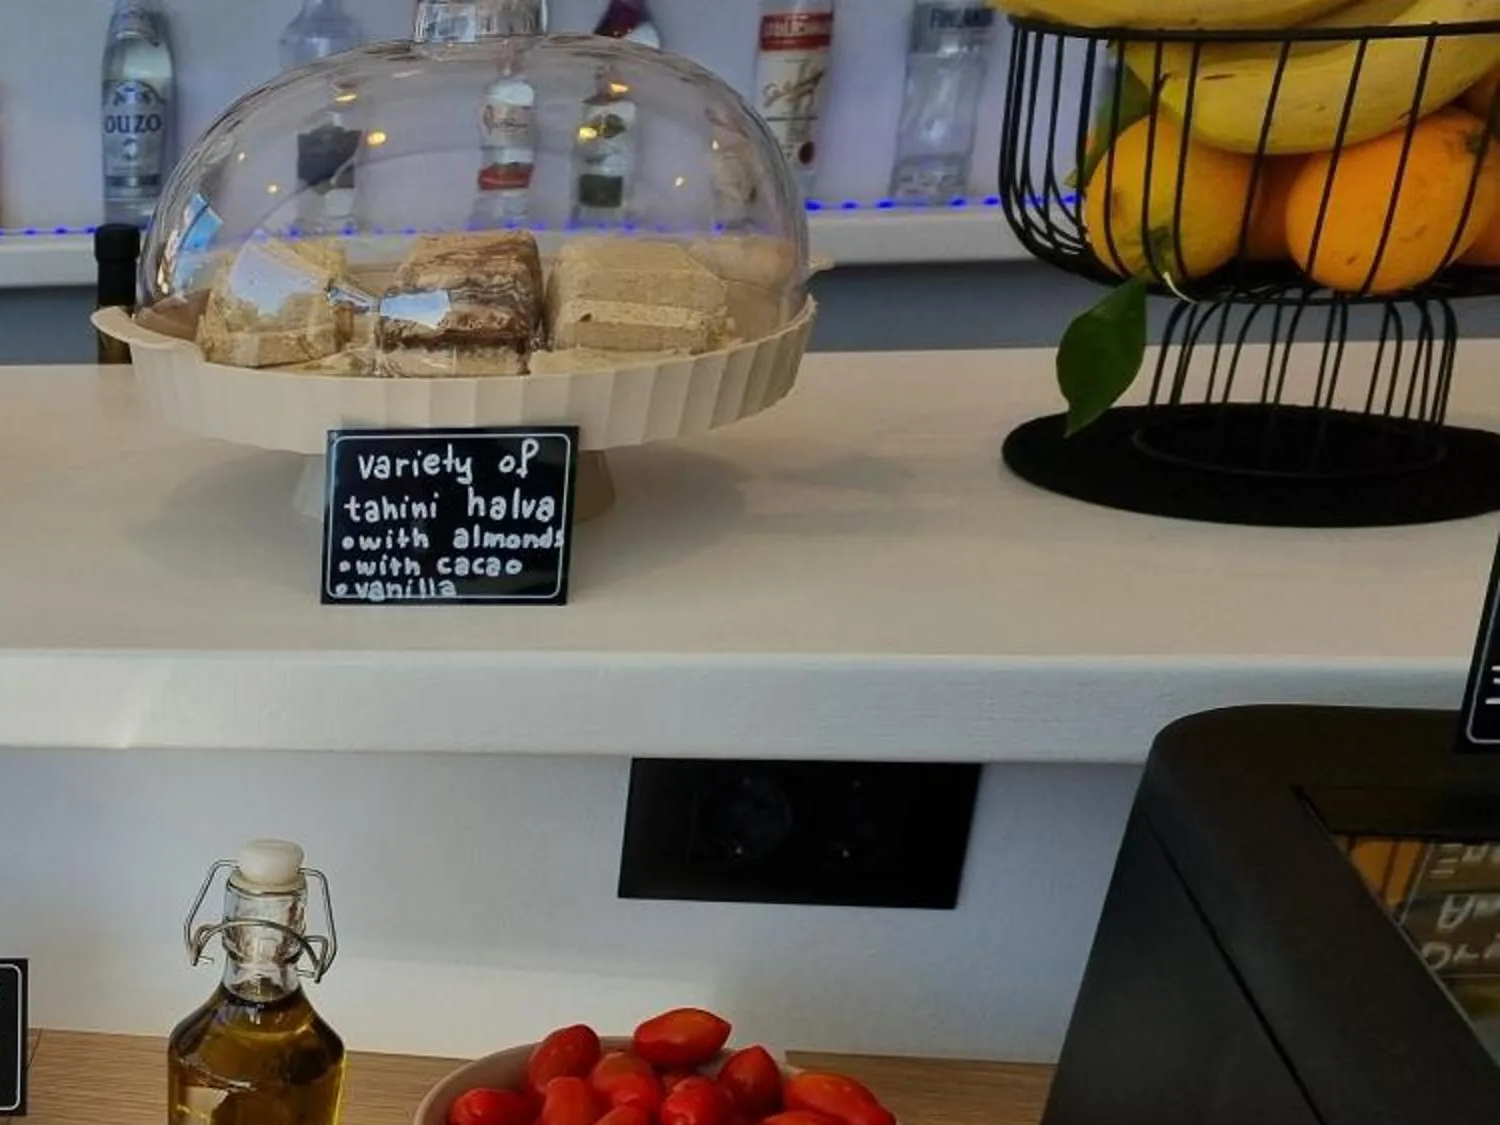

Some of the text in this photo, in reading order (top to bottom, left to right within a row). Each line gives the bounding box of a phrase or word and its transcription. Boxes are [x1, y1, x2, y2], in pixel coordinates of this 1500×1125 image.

[105, 113, 162, 133] OUZO
[358, 438, 540, 485] variety of
[343, 486, 555, 523] tahini halva
[452, 523, 565, 550] almonds
[436, 556, 523, 577] cacao
